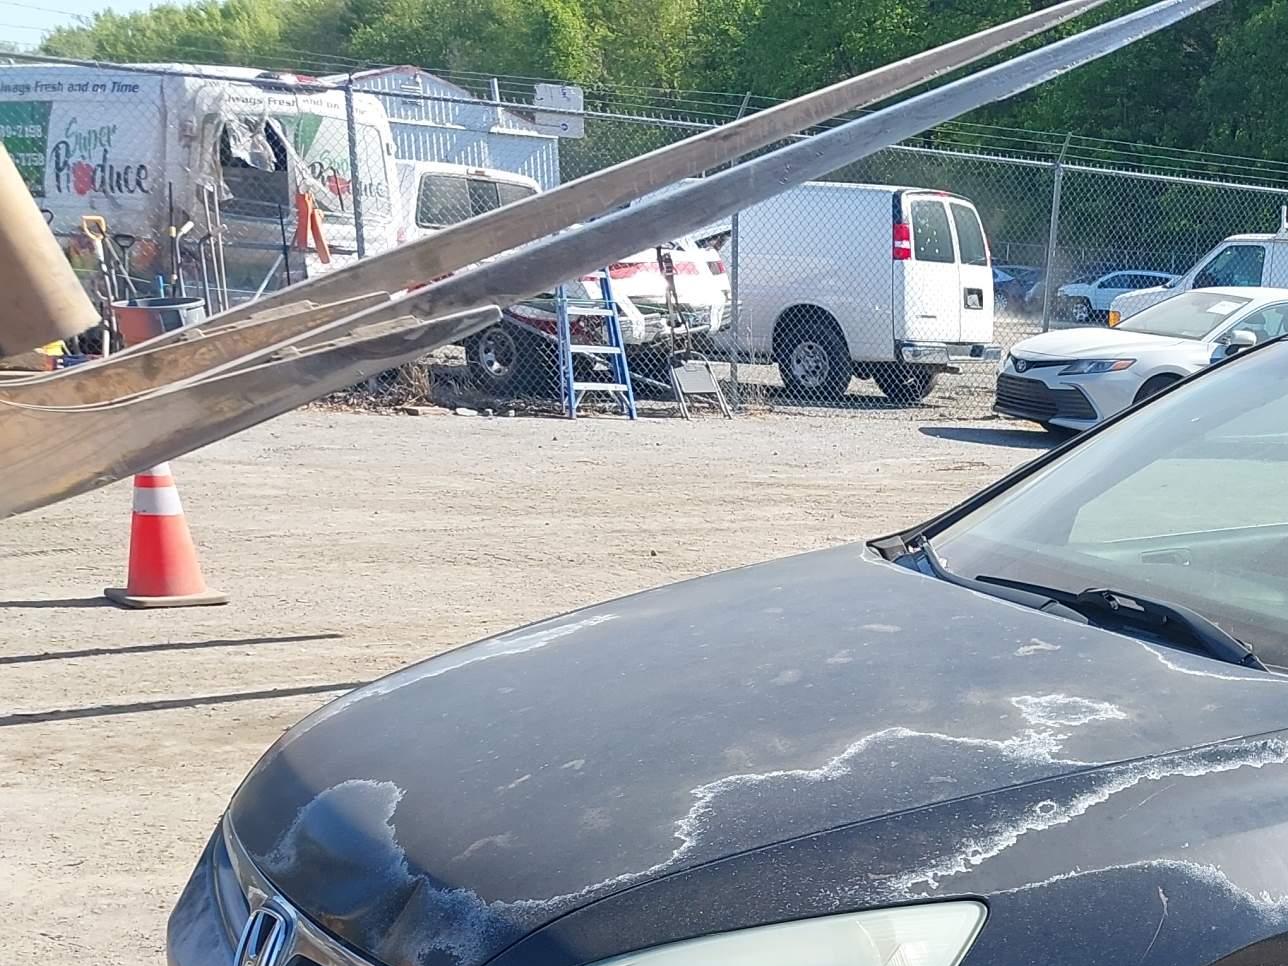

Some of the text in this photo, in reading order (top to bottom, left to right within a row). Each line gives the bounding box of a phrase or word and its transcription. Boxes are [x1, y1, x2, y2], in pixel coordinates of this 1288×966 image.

[0, 81, 140, 95] lways Fresh and on Time
[65, 117, 118, 160] Super
